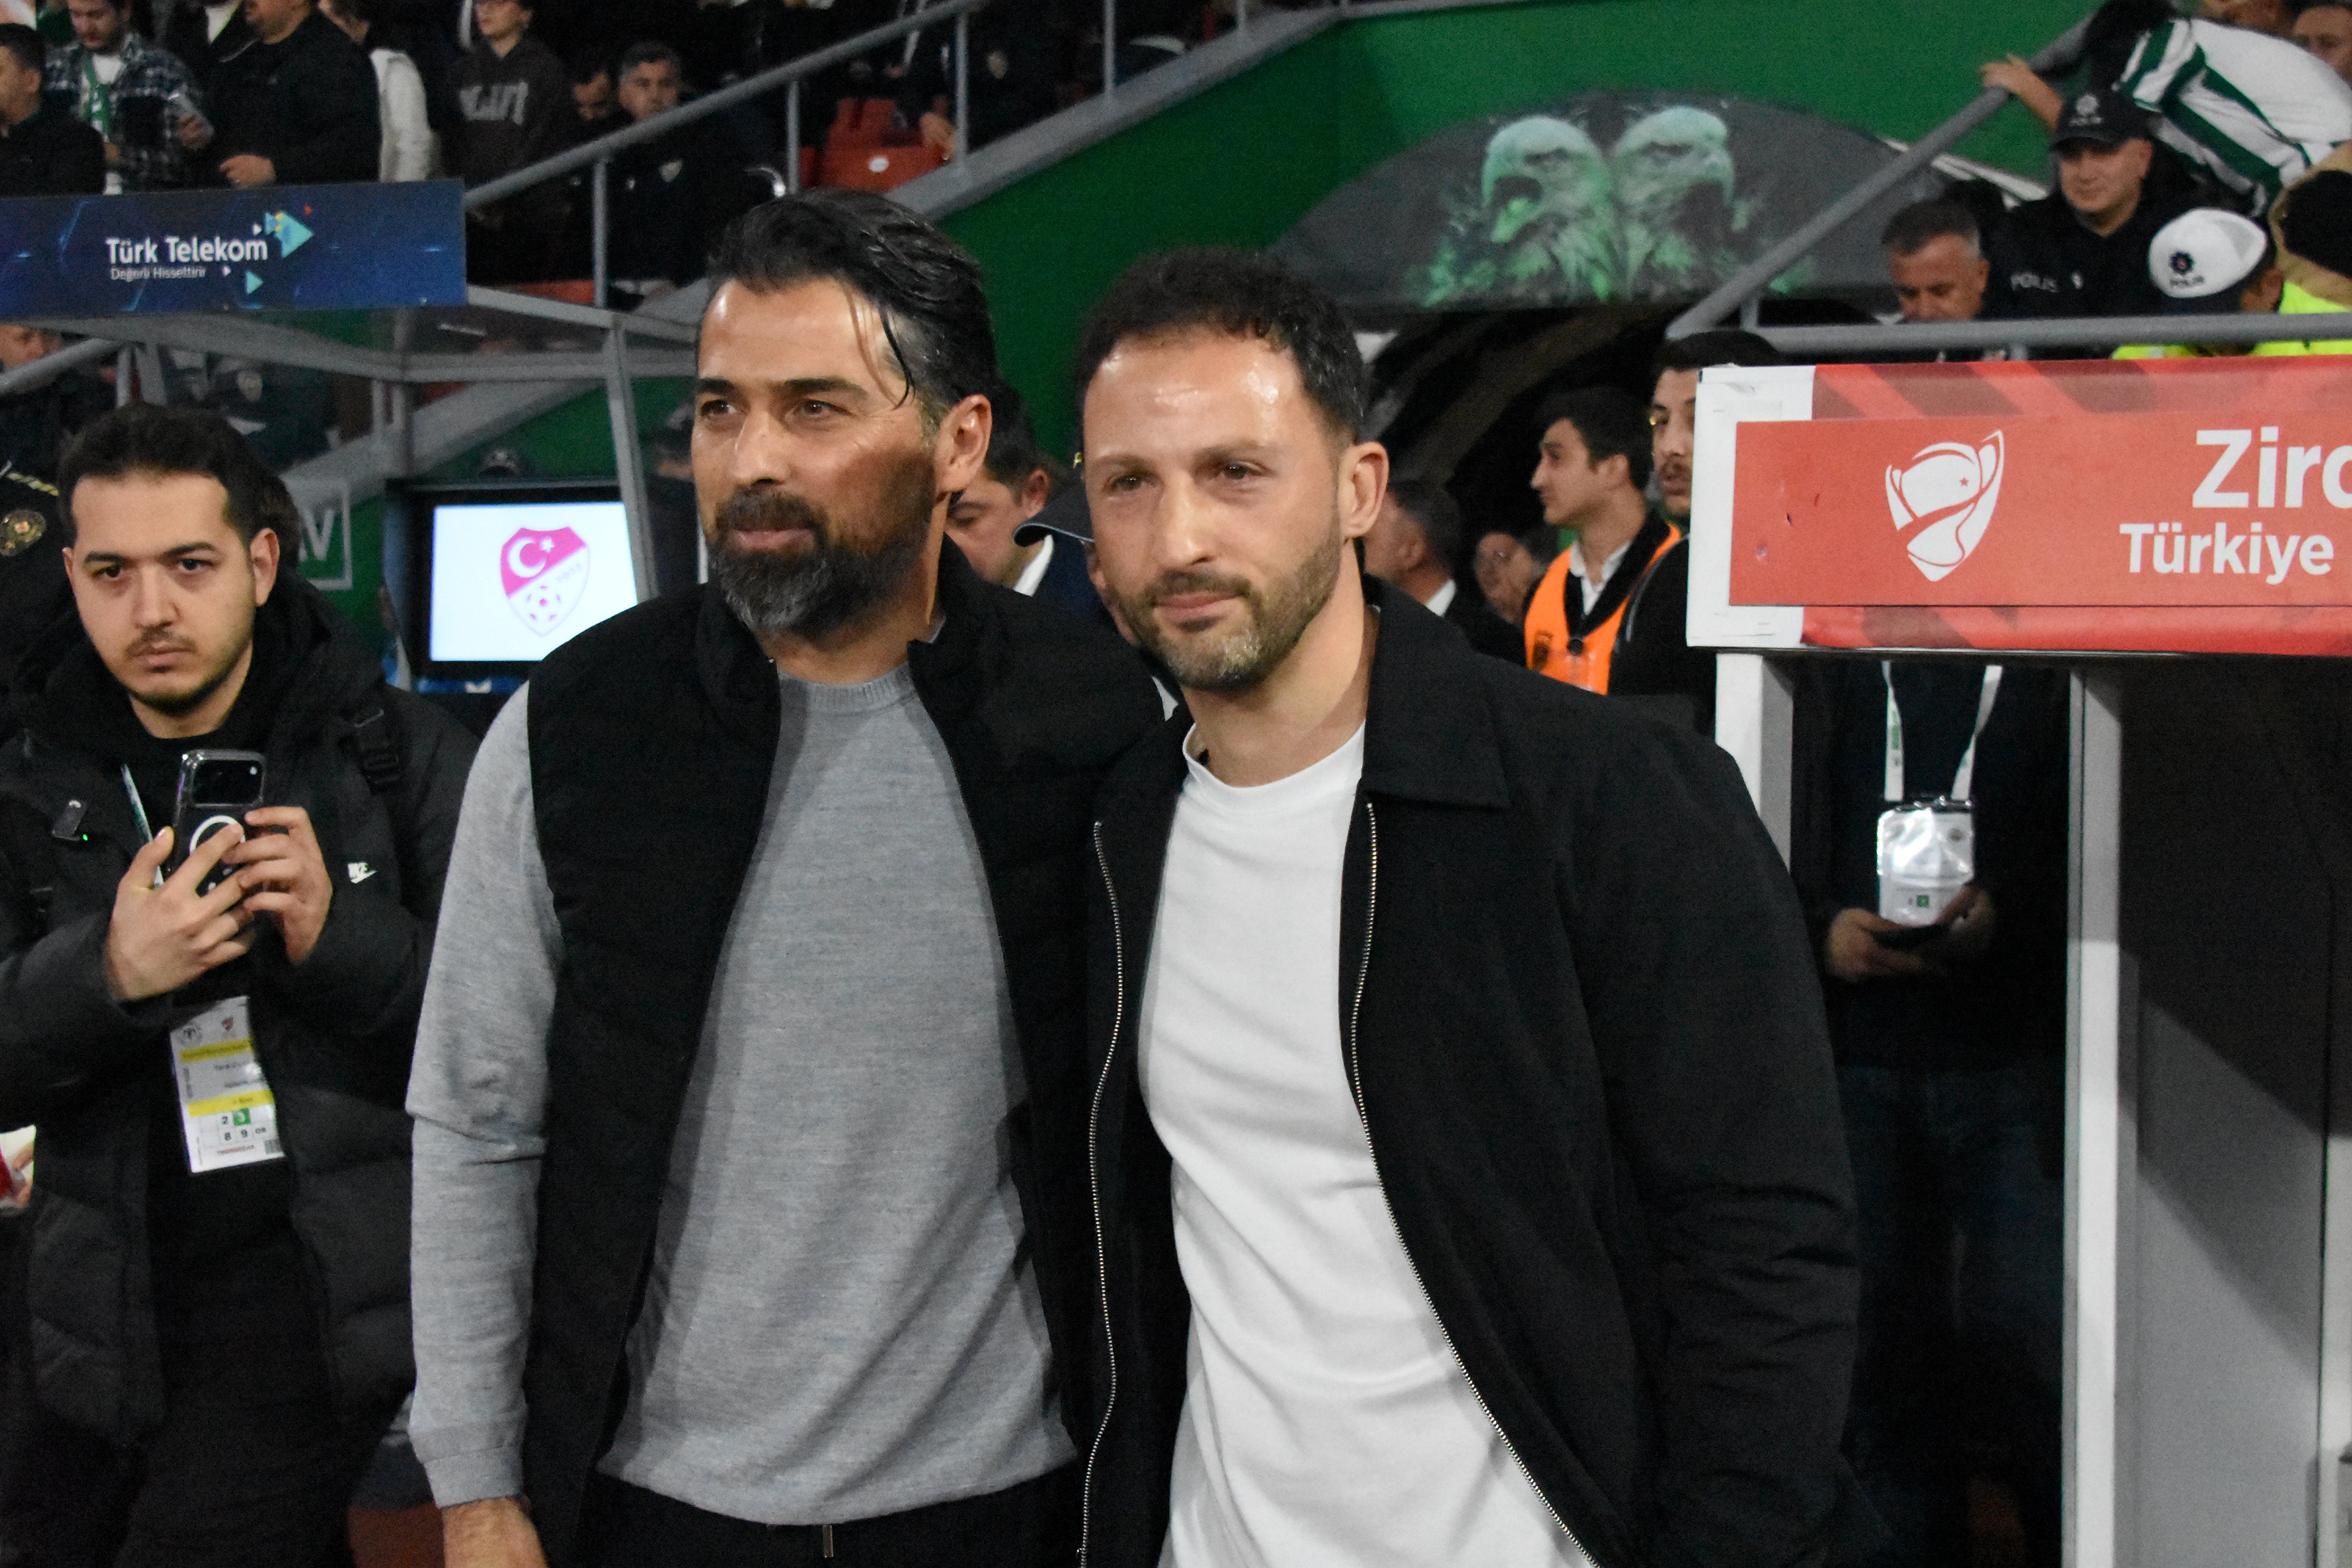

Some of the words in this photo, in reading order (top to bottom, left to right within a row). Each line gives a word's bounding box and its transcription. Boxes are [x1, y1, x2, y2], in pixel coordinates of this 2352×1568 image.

[106, 236, 158, 264] Türk
[165, 236, 268, 263] Telekom
[2119, 522, 2334, 584] Türkiye
